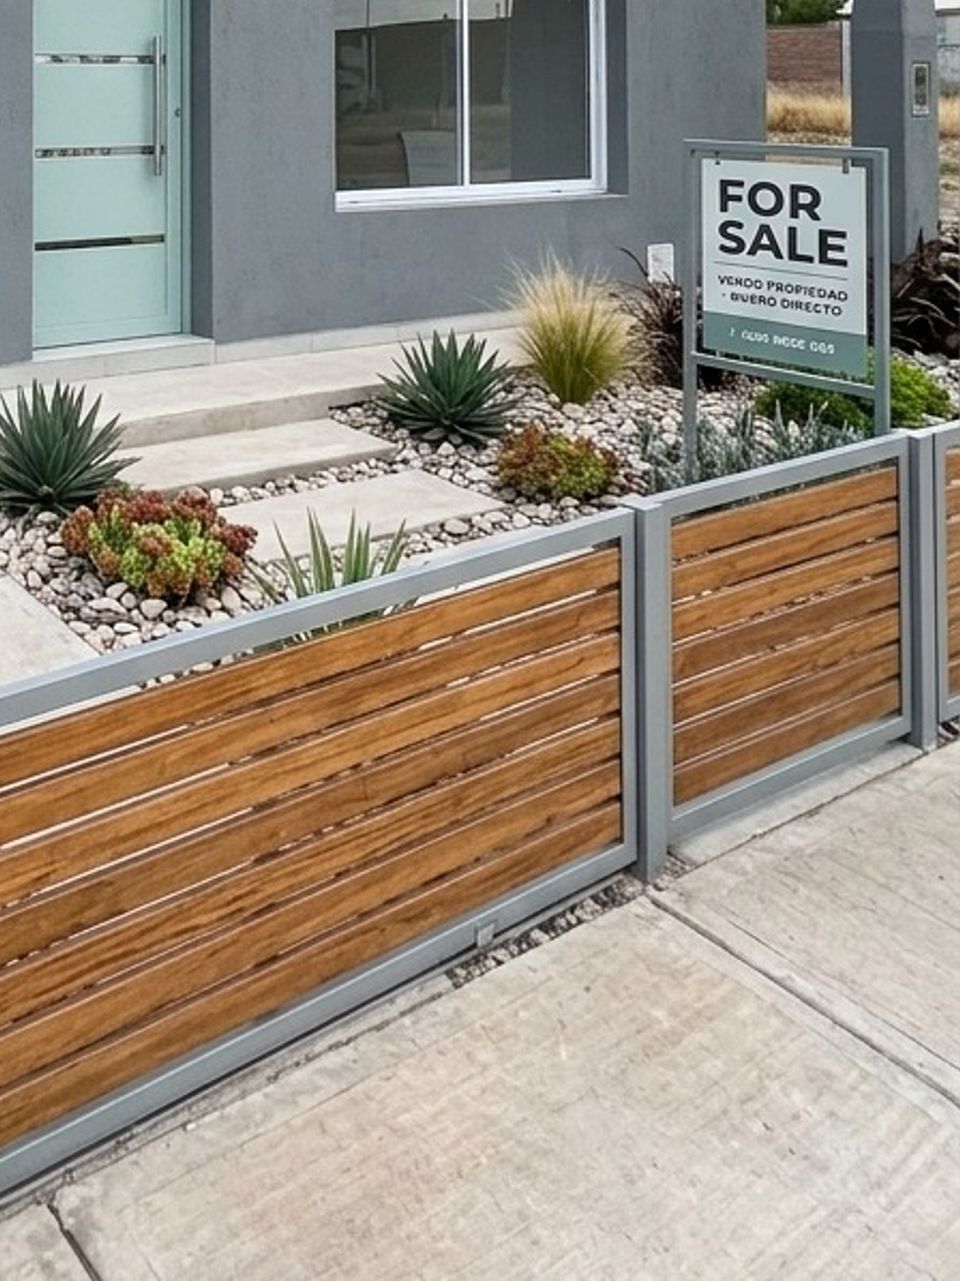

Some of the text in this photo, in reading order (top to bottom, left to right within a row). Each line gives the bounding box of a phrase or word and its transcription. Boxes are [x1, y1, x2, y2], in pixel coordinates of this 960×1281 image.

[719, 179, 821, 221] FOR
[718, 220, 848, 267] SALE
[718, 275, 848, 302] VENDO PROPIEDAD
[780, 298, 843, 317] DIRECTO
